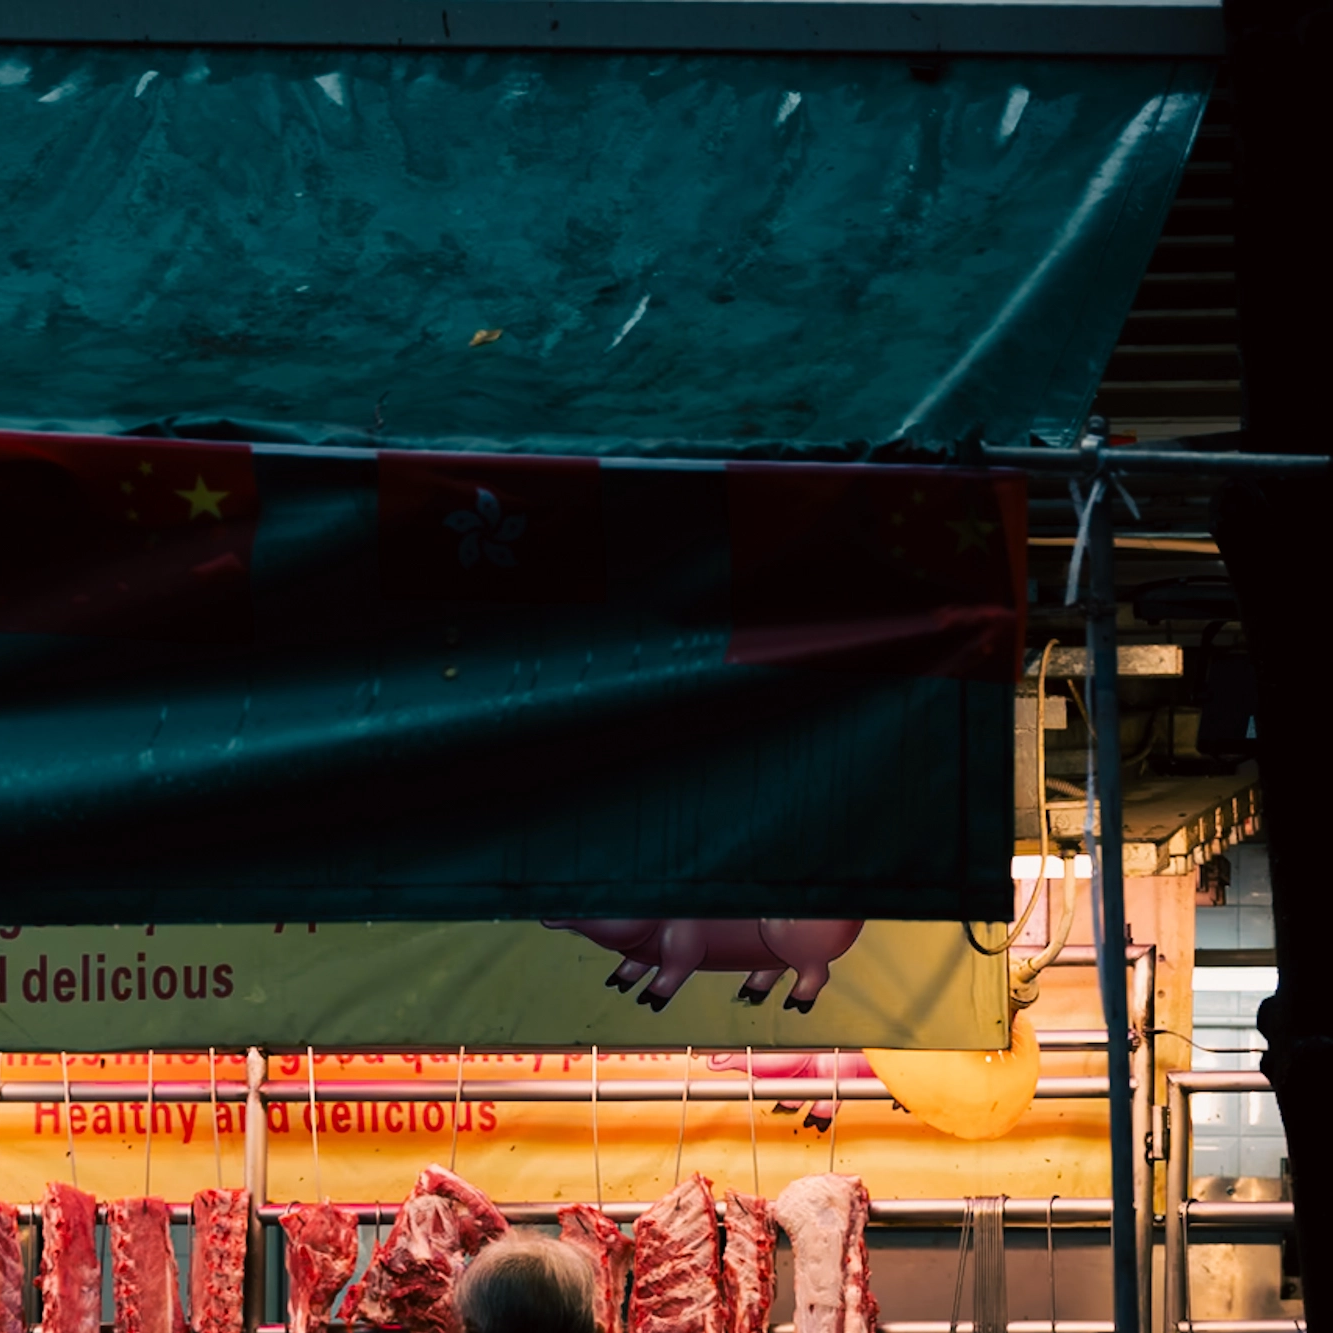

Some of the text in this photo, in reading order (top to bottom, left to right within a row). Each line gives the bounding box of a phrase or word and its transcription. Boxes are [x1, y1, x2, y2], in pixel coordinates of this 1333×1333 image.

[21, 951, 235, 1003] delicious
[34, 1100, 198, 1144] Healthy
[302, 1100, 499, 1134] delicious
